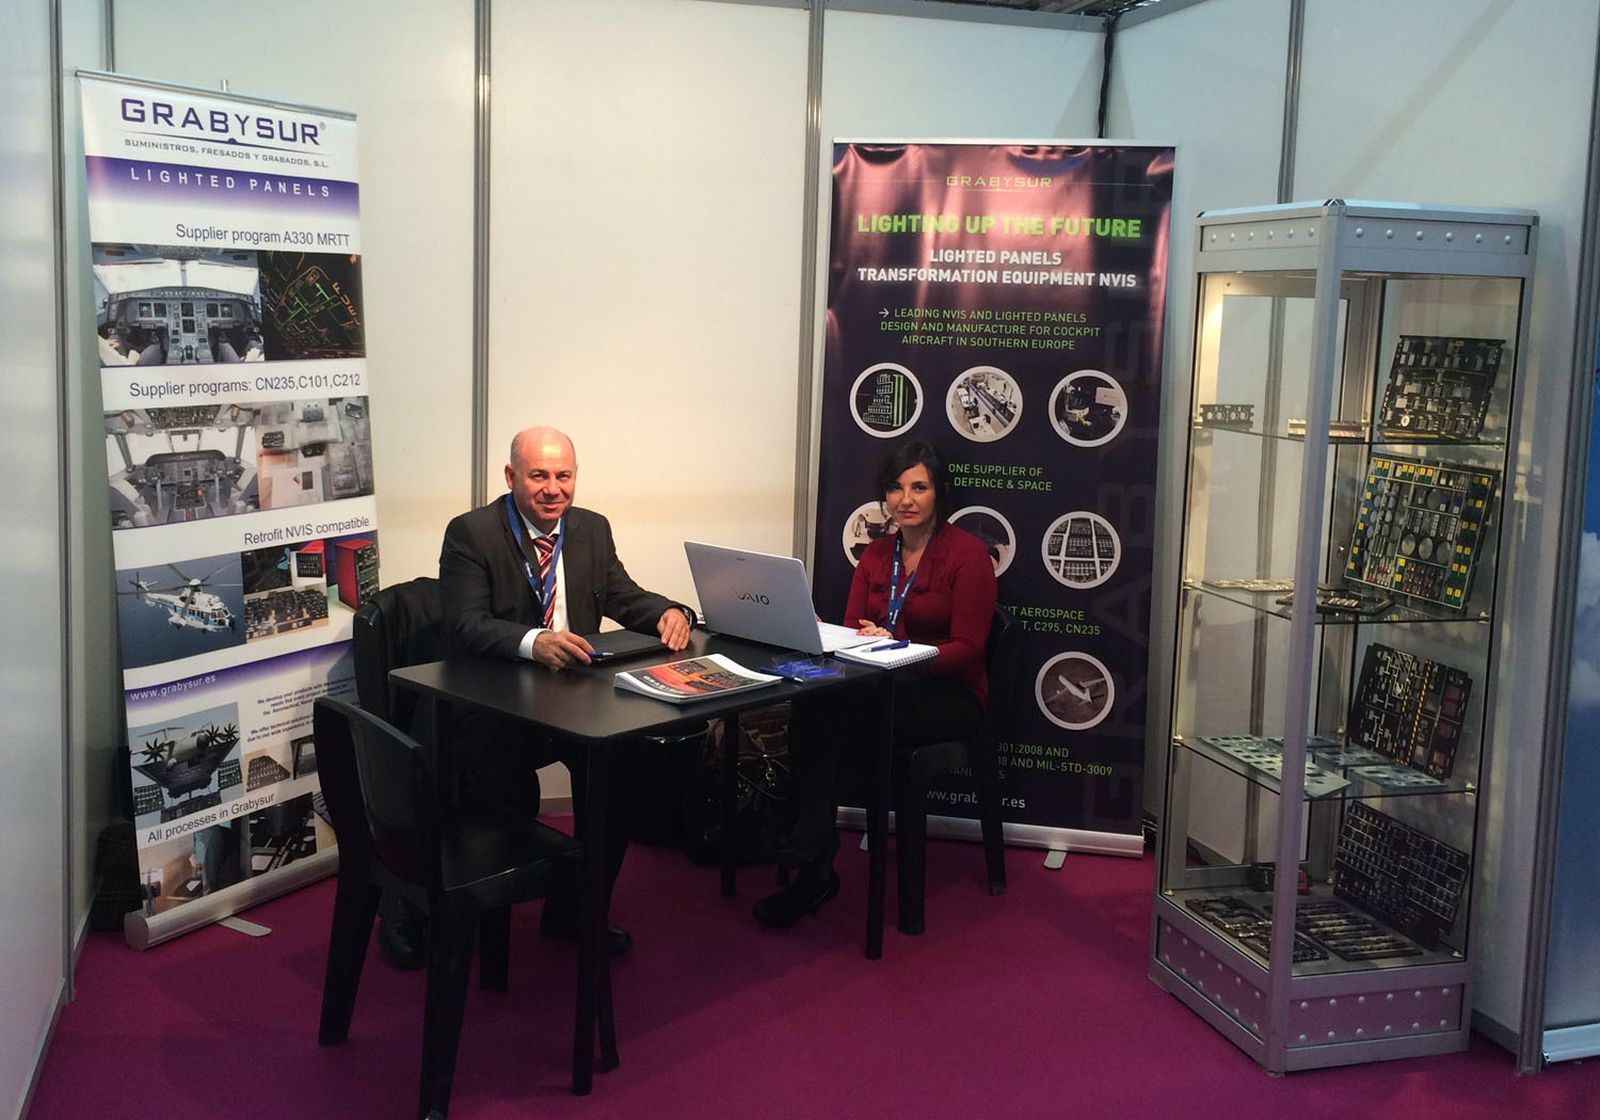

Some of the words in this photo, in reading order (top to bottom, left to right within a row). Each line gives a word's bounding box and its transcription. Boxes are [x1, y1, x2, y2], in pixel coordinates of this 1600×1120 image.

[121, 98, 320, 145] GRABYSUR
[124, 139, 199, 154] SUMINISTROS,
[202, 147, 250, 160] FRESADOS
[262, 154, 311, 167] GRABADOS,
[313, 160, 329, 168] S.L.
[130, 167, 235, 189] LIGHTED
[250, 178, 329, 197] PANELS
[946, 175, 1052, 188] GRABYSUR
[176, 224, 227, 242] Supplier
[233, 230, 280, 246] program
[283, 231, 313, 245] A330
[317, 233, 350, 247] MRTT
[857, 214, 960, 233] LIGHTING
[964, 215, 994, 234] UP
[1000, 216, 1044, 236] THE
[1051, 218, 1141, 238] FUTURE
[930, 249, 996, 264] LIGHTED
[1000, 250, 1062, 265] PANELS
[858, 267, 998, 284] TRANSFORMATION
[1002, 270, 1095, 286] EQUIPMENT
[1099, 272, 1137, 288] NVIS
[894, 308, 940, 319] LEADING
[943, 309, 967, 320] NVIS
[970, 310, 992, 320] AND
[995, 311, 1041, 322] LIGHTED
[1044, 312, 1087, 323] PANELS
[880, 321, 918, 331] DESIGN
[921, 322, 944, 332] AND
[946, 323, 1026, 335] MANUFACTURE
[1029, 325, 1051, 336] FOR
[1053, 326, 1101, 337] COCKPIT
[902, 335, 953, 346] AIRCRAFT
[956, 336, 967, 346] IN
[970, 337, 1028, 348] SOUTHERN
[1032, 339, 1075, 350] EUROPE
[129, 381, 184, 399] Supplier
[189, 379, 252, 396] programs:
[948, 463, 971, 474] ONE
[973, 464, 1026, 476] SUPPLIER
[1028, 467, 1044, 477] OF
[954, 477, 1003, 489] DEFENCE
[1006, 479, 1014, 489] &
[1017, 480, 1052, 492] SPACE
[244, 529, 283, 546] Retrofit
[286, 524, 313, 539] NVIS
[316, 516, 369, 535] compatible
[1020, 606, 1085, 621] AEROSPACE
[1034, 621, 1063, 634] C295,
[1065, 623, 1101, 636] CN235
[129, 673, 216, 701] www.grabysur.es
[1046, 746, 1069, 758] AND
[1010, 757, 1033, 769] AND
[1036, 761, 1113, 776] MIL-STD-3009
[147, 828, 162, 844] All
[165, 812, 217, 840] processes
[219, 807, 229, 818] in
[231, 792, 275, 814] Grabysur
